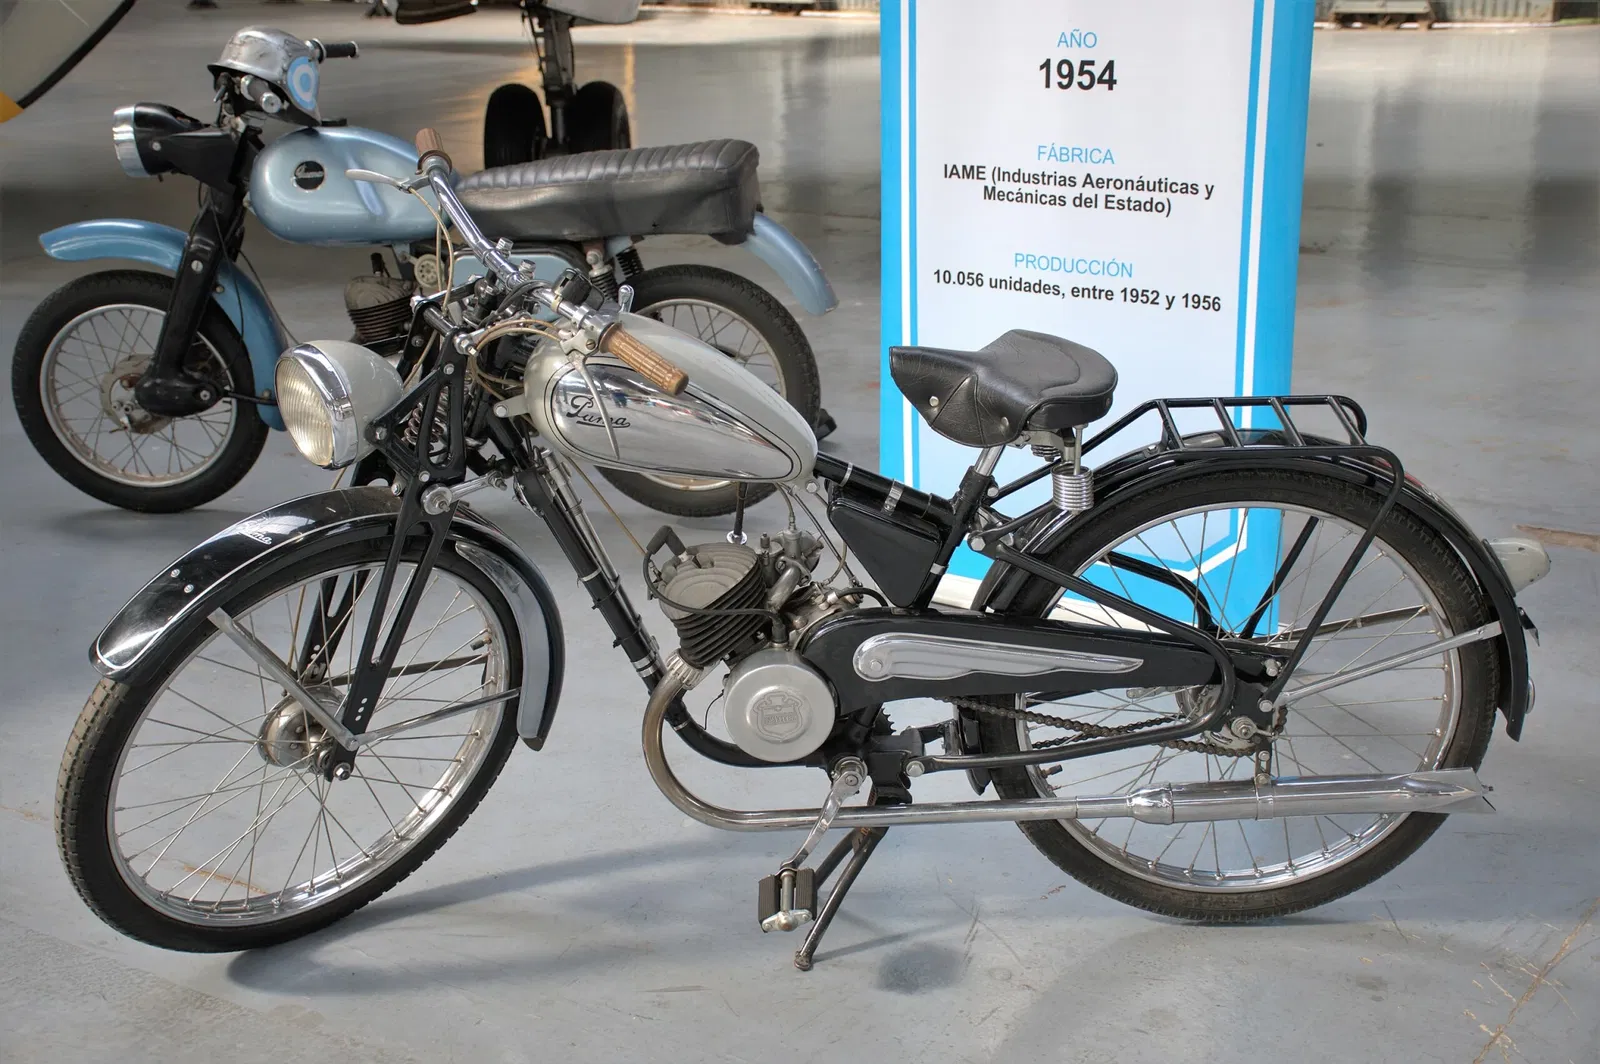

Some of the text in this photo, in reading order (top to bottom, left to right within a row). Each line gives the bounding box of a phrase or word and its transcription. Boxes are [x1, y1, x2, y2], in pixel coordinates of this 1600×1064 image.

[1056, 28, 1098, 49] AÑO
[1038, 57, 1118, 92] 1954
[1037, 142, 1115, 165] FÁBRICA
[943, 163, 1215, 201] IAME (Industrias Aeronáuticas y
[983, 184, 1172, 219] Mecánicas del Estado)
[1014, 252, 1133, 279] PRODUCCIÓN
[933, 268, 1222, 313] 10.056 unidades, entre 1952 y 1956
